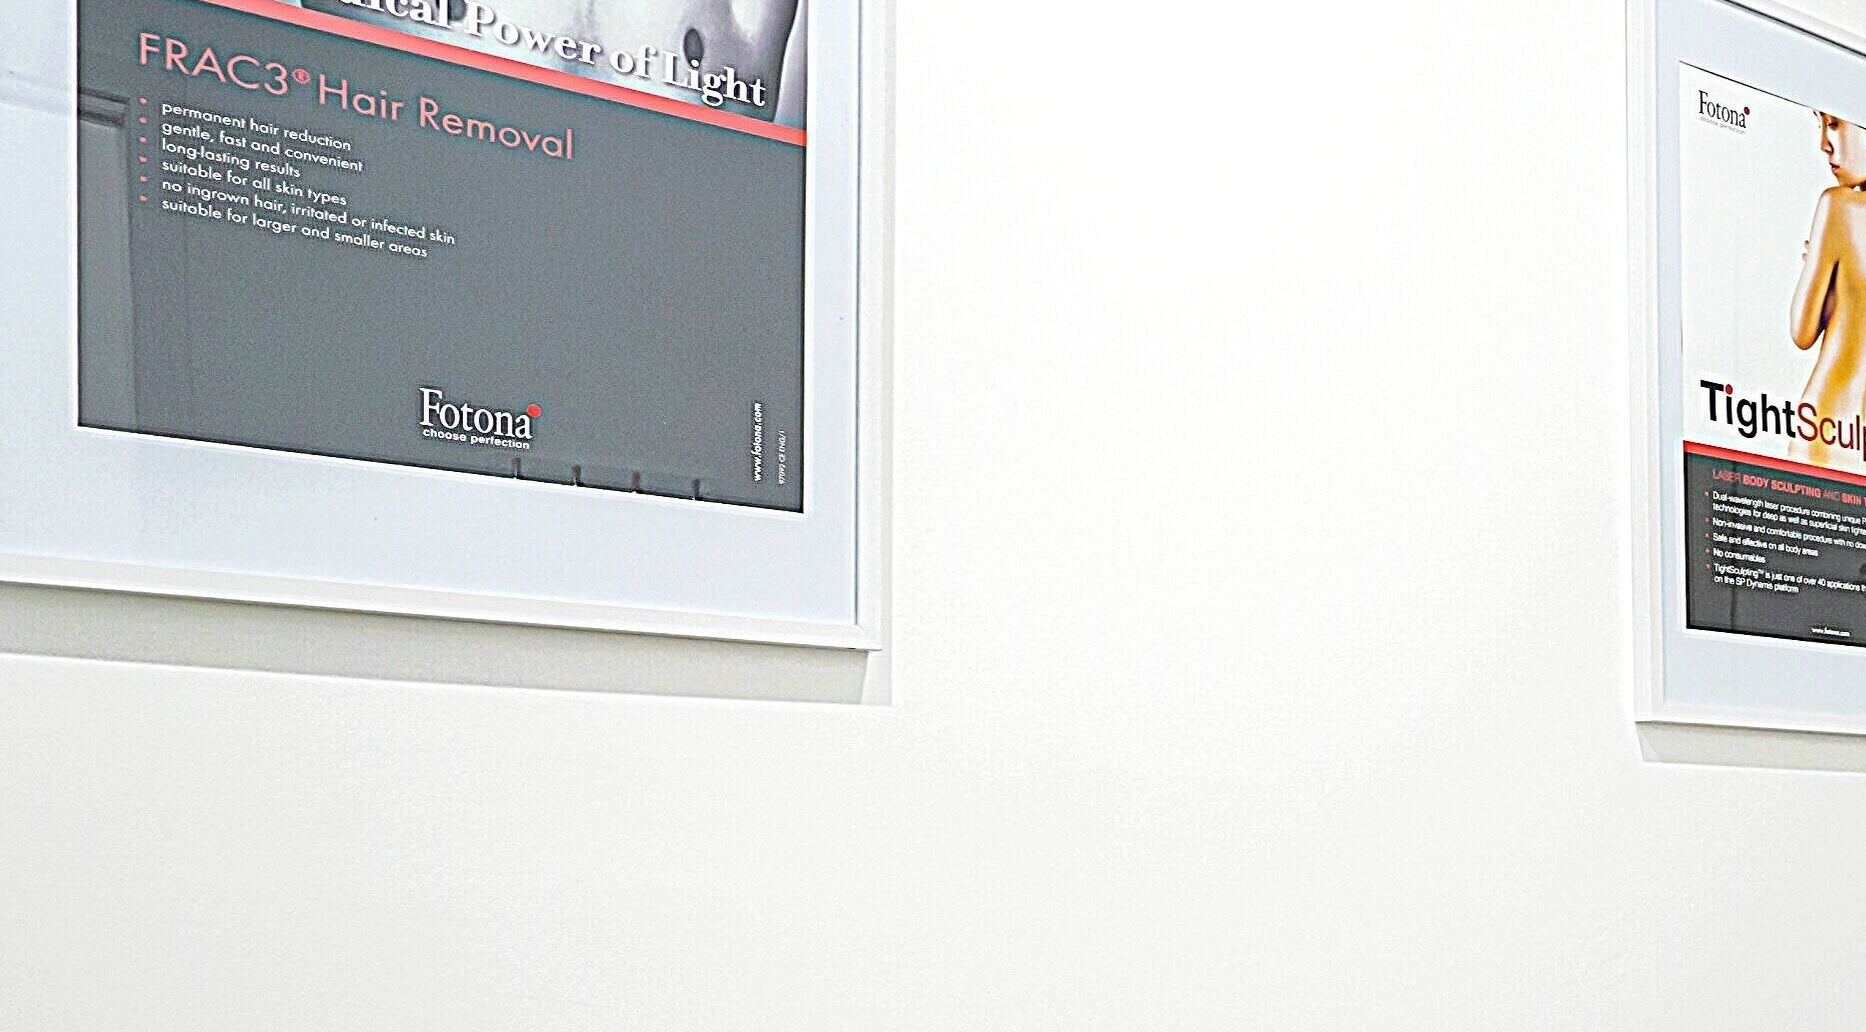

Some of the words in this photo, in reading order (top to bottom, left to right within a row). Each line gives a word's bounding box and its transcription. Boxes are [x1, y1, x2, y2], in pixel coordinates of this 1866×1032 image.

[464, 1, 601, 65] Power
[609, 45, 661, 80] of
[663, 51, 767, 107] Light
[162, 103, 246, 129] permanent
[250, 118, 280, 136] hair
[283, 128, 352, 151] reduction
[318, 73, 404, 121] Hair
[419, 96, 574, 159] Removal
[1698, 89, 1747, 129] Fotona
[162, 122, 215, 143] gentle,
[219, 130, 247, 148] fast
[250, 142, 281, 155] and
[284, 148, 364, 172] convenient
[162, 137, 250, 171] long-lasting
[255, 159, 301, 178] results
[162, 161, 222, 181] suitable
[226, 169, 248, 186] for
[252, 177, 271, 191] all
[275, 180, 303, 197] skin
[307, 188, 347, 206] types
[162, 181, 183, 192] no
[187, 182, 250, 205] ingrown
[254, 194, 287, 214] hair,
[291, 203, 348, 224] irritated
[351, 217, 367, 228] or
[371, 218, 426, 239] infected
[429, 228, 455, 245] skin
[162, 200, 222, 220] suitable
[227, 207, 249, 224] for
[252, 213, 297, 234] larger
[301, 226, 330, 239] and
[334, 232, 385, 249] smaller
[388, 241, 428, 257] areas
[419, 387, 533, 440] Fotona
[422, 428, 467, 442] choose
[470, 435, 530, 450] perfection
[750, 402, 762, 481] www.fotona.com
[1743, 474, 1769, 488] BODY
[1771, 480, 1821, 498] SCULPTING
[1841, 492, 1861, 506] SKIN
[1712, 502, 1752, 517] technologies
[1753, 509, 1761, 517] for
[1762, 511, 1779, 521] deep
[1779, 514, 1787, 522] as
[1788, 516, 1800, 524] well
[1800, 518, 1808, 526] as
[1808, 519, 1838, 531] superficial
[1838, 523, 1850, 533] skin
[1764, 500, 1779, 510] laser
[1780, 503, 1810, 517] procedure
[1811, 508, 1841, 522] combining
[1842, 514, 1861, 526] unique
[1712, 532, 1728, 542] Safe
[1728, 536, 1742, 545] and
[1742, 537, 1768, 549] effective
[1768, 542, 1777, 550] on
[1777, 543, 1785, 551] all
[1785, 544, 1801, 556] body
[1713, 547, 1724, 557] No
[1724, 550, 1766, 564] consumables
[1753, 525, 1765, 534] and
[1766, 526, 1802, 540] comfortable
[1803, 533, 1833, 546] procedure
[1833, 538, 1846, 547] with
[1846, 540, 1855, 548] no
[1713, 575, 1723, 583] on
[1724, 575, 1735, 584] the
[1735, 576, 1746, 586] SP
[1773, 582, 1800, 593] platform
[1771, 572, 1783, 582] just
[1783, 574, 1796, 583] one
[1796, 575, 1803, 583] of
[1803, 577, 1818, 585] over
[1817, 578, 1826, 587] 40
[1826, 580, 1861, 593] applications
